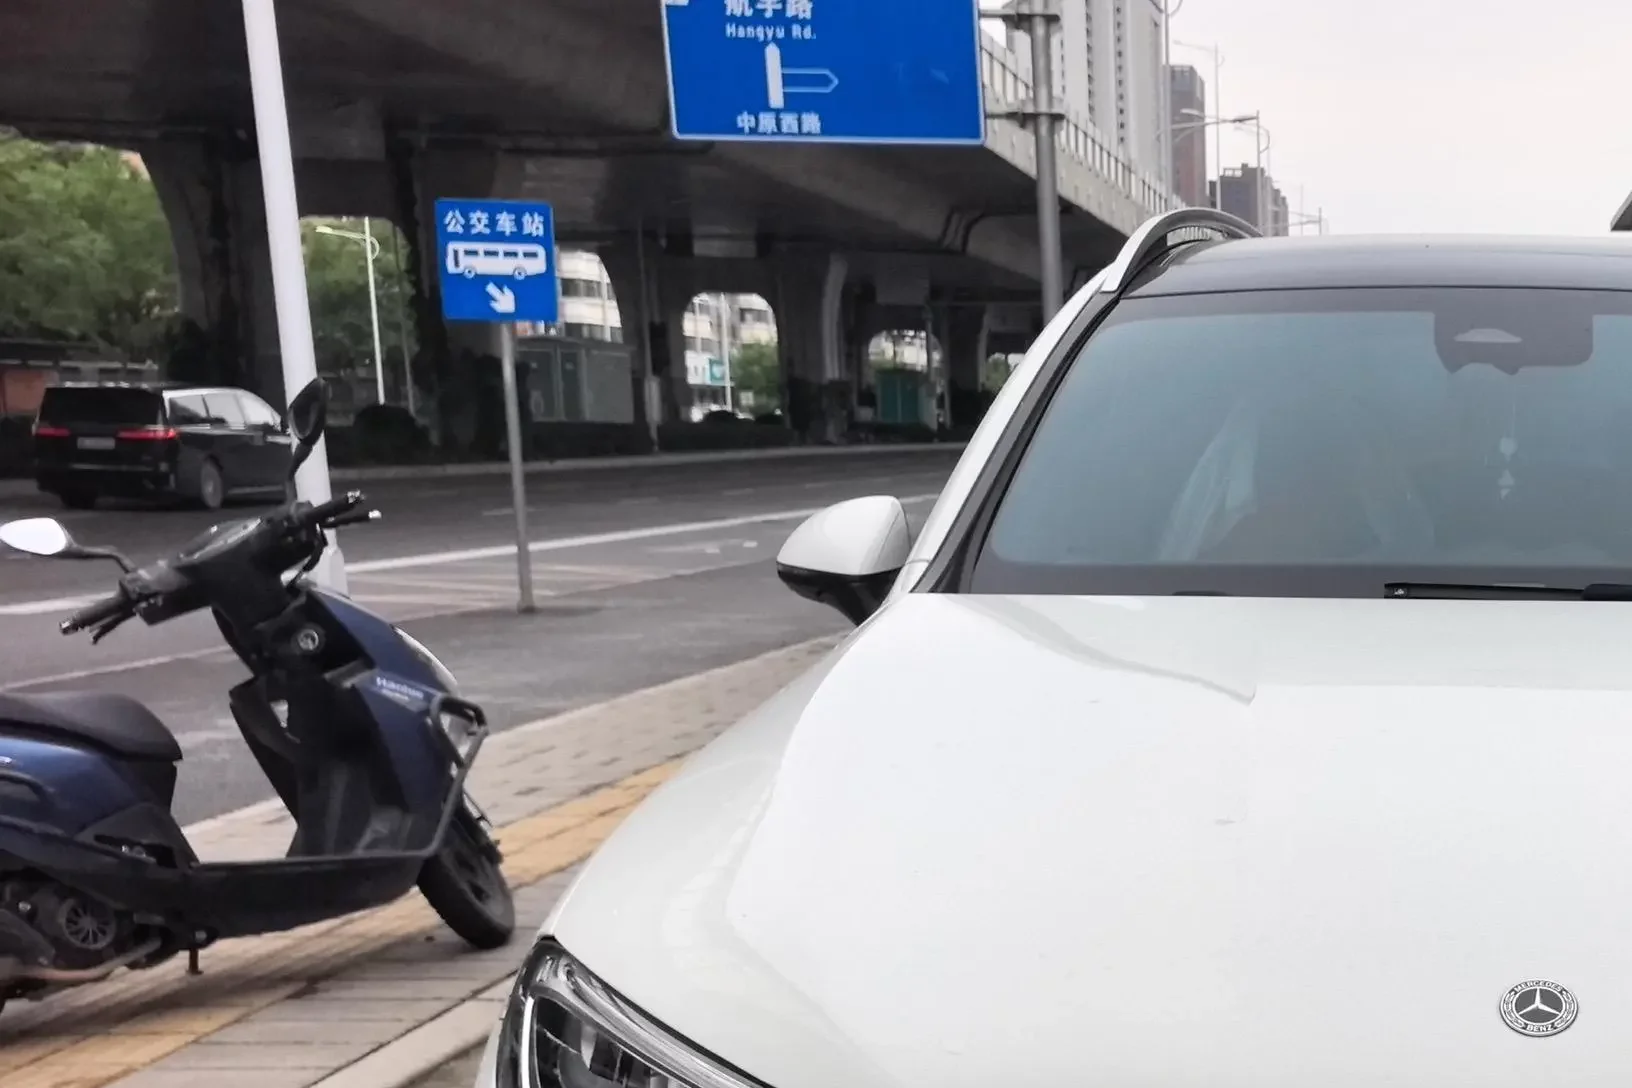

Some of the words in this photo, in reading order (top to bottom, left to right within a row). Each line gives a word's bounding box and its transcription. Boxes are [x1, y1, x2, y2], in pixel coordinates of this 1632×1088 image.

[725, 22, 785, 42] Hangyu
[791, 23, 817, 40] Rd.
[737, 111, 821, 135] 中原西路
[443, 208, 545, 237] 公交车站
[1526, 1024, 1554, 1032] BENZ
